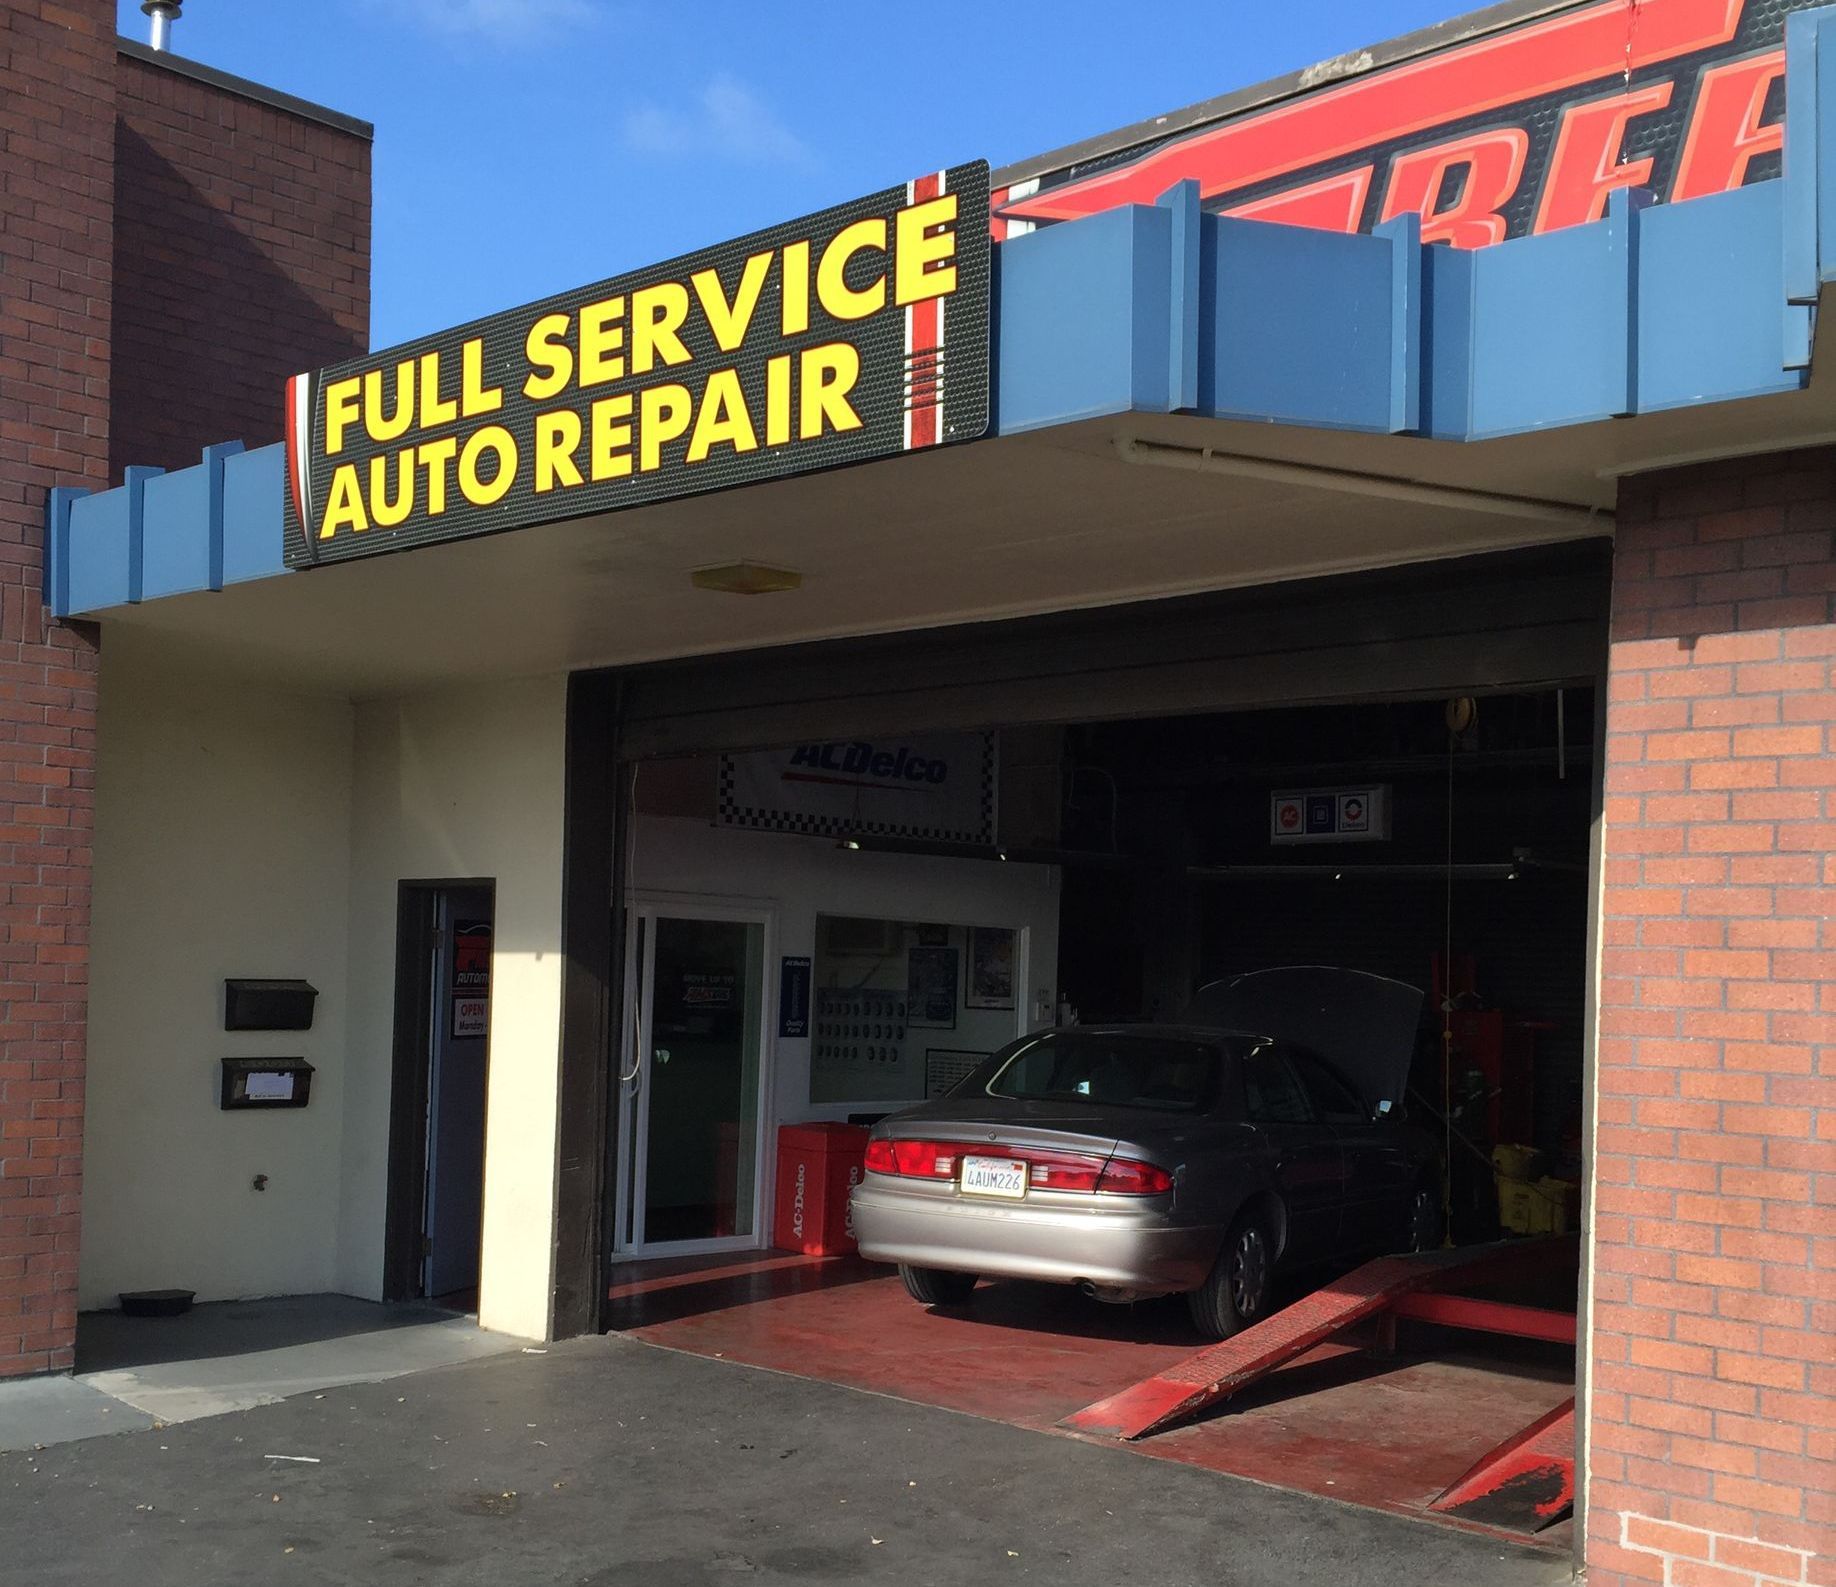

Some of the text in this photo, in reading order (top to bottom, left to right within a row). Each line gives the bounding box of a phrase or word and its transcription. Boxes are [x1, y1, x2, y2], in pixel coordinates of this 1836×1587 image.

[325, 194, 958, 455] FULL SERVICE
[319, 342, 864, 541] AUTO REPAIR
[790, 741, 948, 785] ACDelco
[457, 972, 490, 985] AUTOM
[461, 1004, 485, 1016] OPEN
[967, 1170, 1021, 1191] 4AUM226
